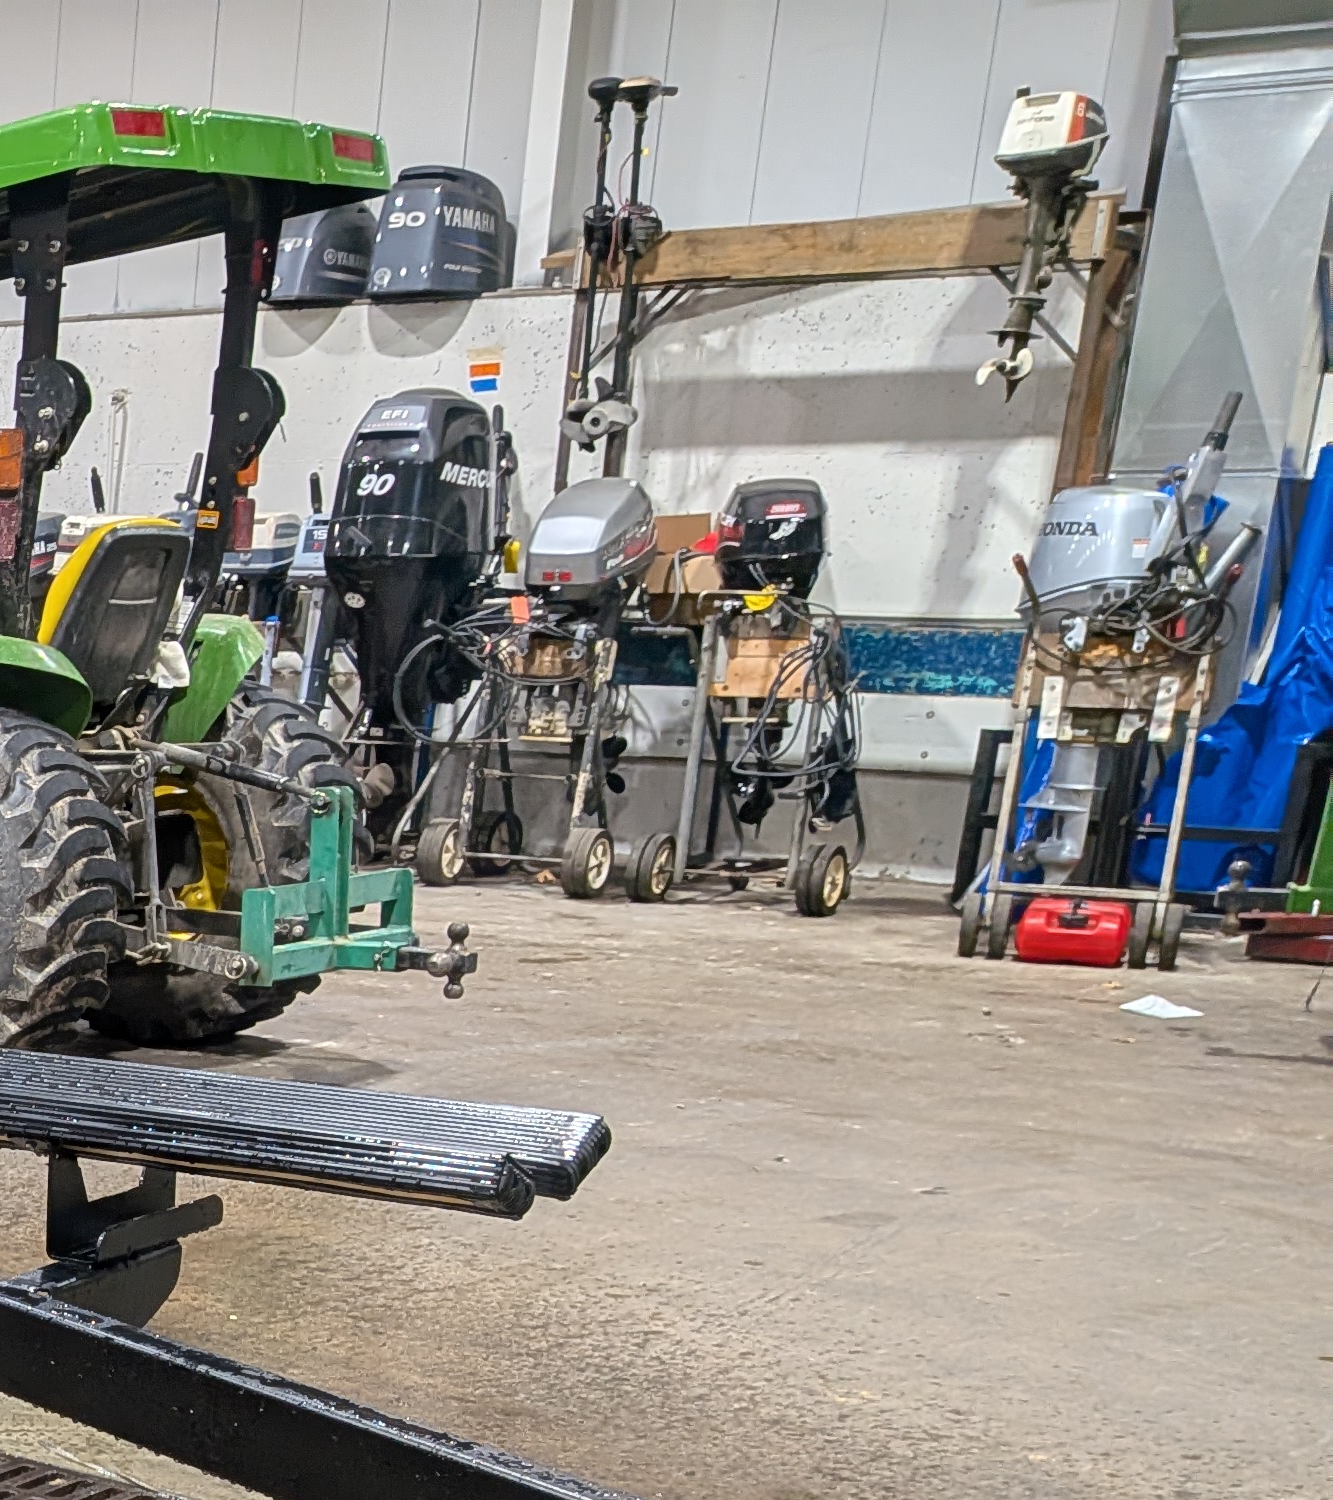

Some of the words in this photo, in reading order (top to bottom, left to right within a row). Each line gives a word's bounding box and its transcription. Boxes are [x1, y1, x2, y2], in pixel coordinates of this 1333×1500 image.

[387, 211, 426, 229] 90
[442, 205, 496, 234] YAMAHA
[380, 409, 409, 420] EFI
[356, 473, 396, 496] 90
